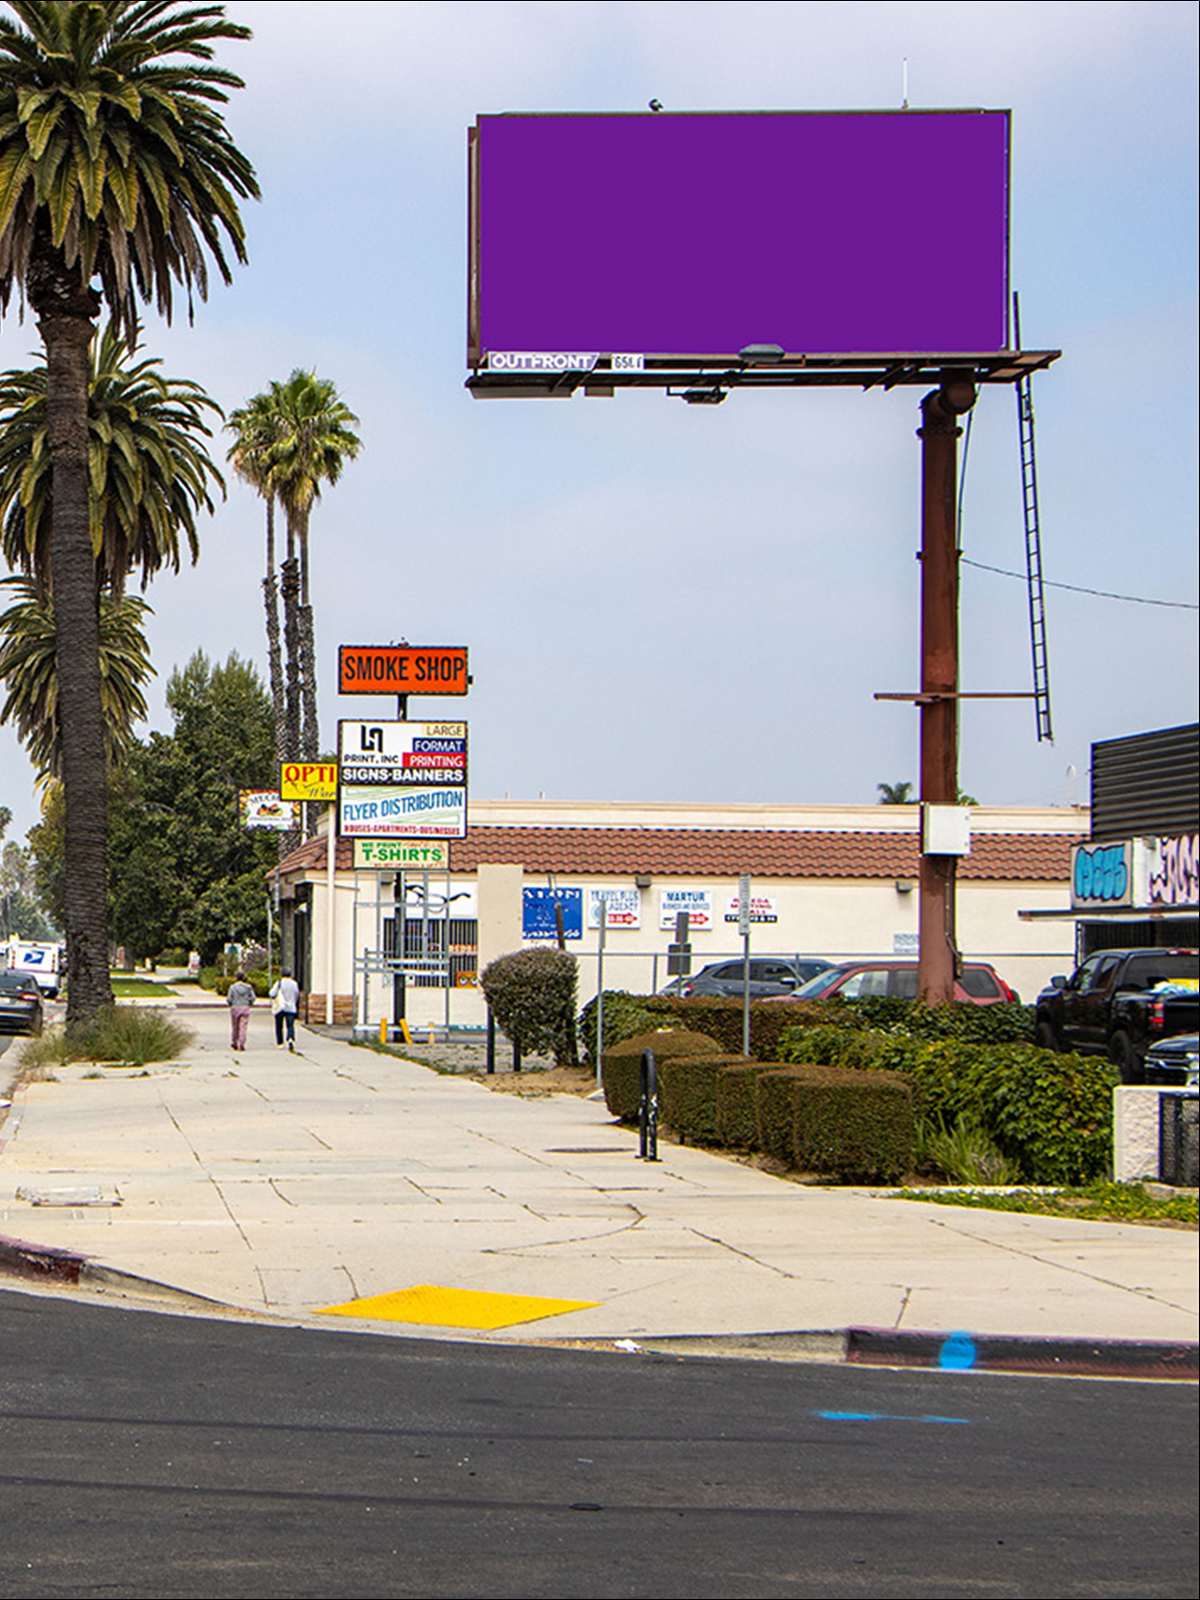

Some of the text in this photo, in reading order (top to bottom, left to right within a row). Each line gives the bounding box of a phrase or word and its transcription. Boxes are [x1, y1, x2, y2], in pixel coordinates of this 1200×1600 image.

[492, 354, 592, 369] OUTFRONT
[345, 656, 465, 680] SMOKE SHOP
[426, 725, 463, 736] LARGE
[414, 740, 463, 752] FORMAT
[381, 755, 399, 764] INC
[410, 755, 464, 768] PRINTING
[343, 790, 463, 821] FLYER DISTRIBUTION
[362, 848, 442, 861] T-SHIRTS
[667, 892, 705, 902] MARTUR
